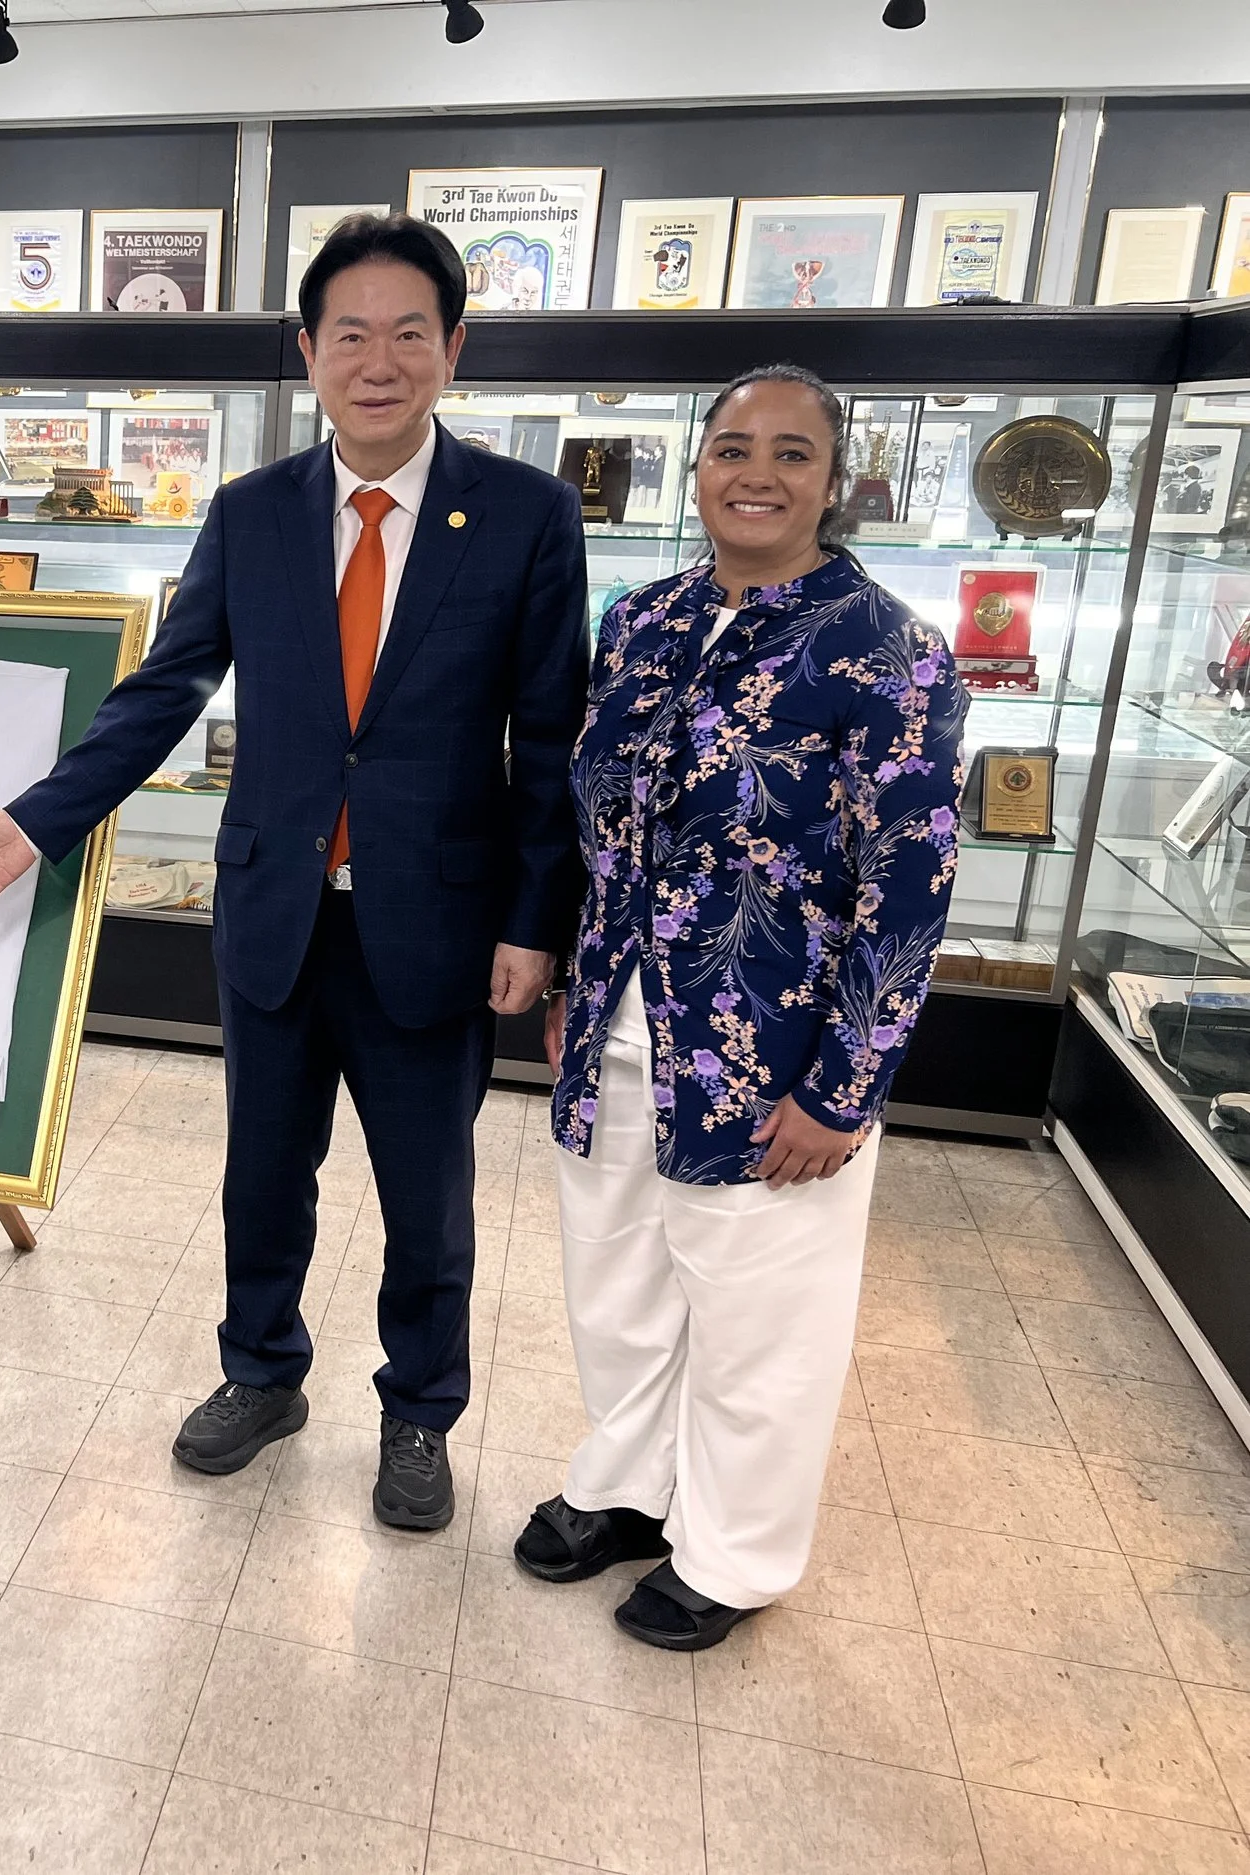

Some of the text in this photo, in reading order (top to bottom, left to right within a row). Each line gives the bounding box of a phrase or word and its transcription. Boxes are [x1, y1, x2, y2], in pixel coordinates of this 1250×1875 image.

[442, 188, 465, 204] 3rd
[469, 189, 493, 204] Tae
[497, 188, 536, 203] Kwon
[423, 206, 578, 223] World Championships
[104, 235, 203, 248] 4. TAEKWONDO
[105, 248, 199, 257] WELTMEISTERSCHAFT
[19, 243, 52, 290] 5
